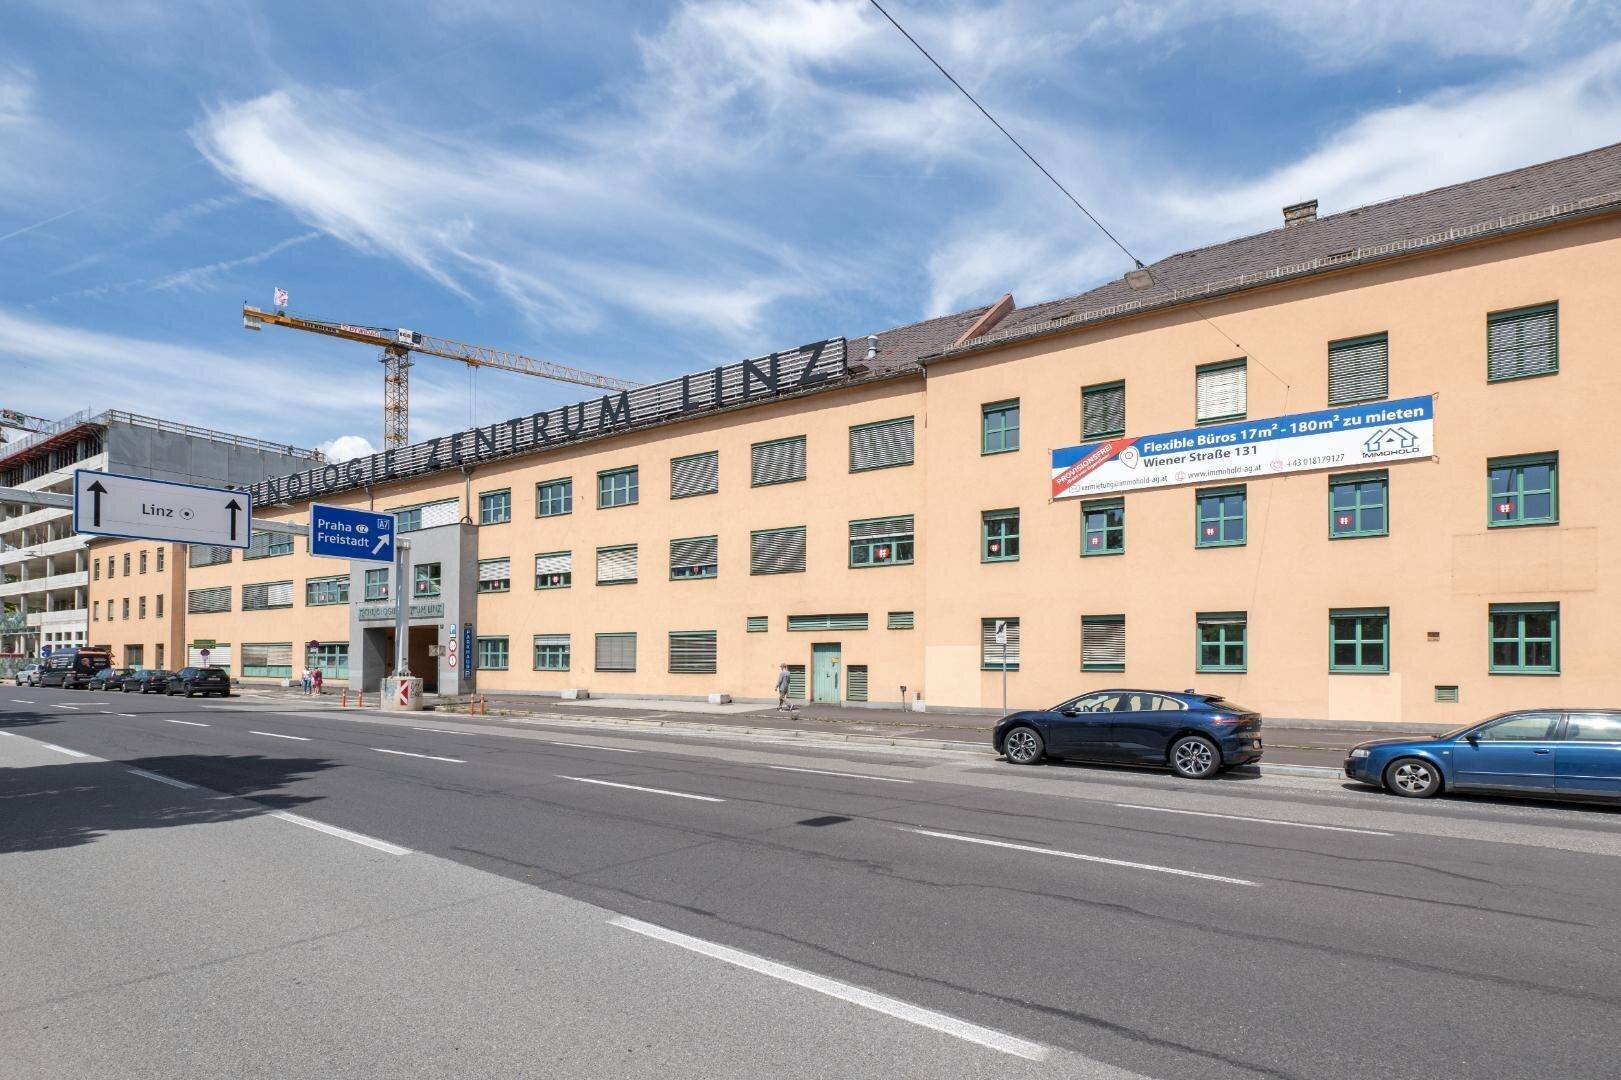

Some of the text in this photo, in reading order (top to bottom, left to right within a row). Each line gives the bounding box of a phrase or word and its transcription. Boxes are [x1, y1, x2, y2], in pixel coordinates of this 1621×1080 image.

[426, 389, 632, 469] ZENTRUM
[682, 339, 829, 412] LINZ
[1144, 437, 1194, 453] Flexible
[1197, 431, 1237, 446] Büros
[1240, 423, 1278, 440] 17m²
[1289, 414, 1340, 434] 180m²
[1342, 415, 1362, 427] zu
[1366, 406, 1424, 423] mieten
[1056, 444, 1113, 484] PROVISIONSFREI
[1143, 445, 1257, 468] Wiener Straße 131
[1286, 458, 1301, 468] +43
[142, 503, 174, 518] Linz
[318, 518, 352, 532] Praha
[379, 519, 389, 530] A7
[317, 532, 370, 548] Freistadt
